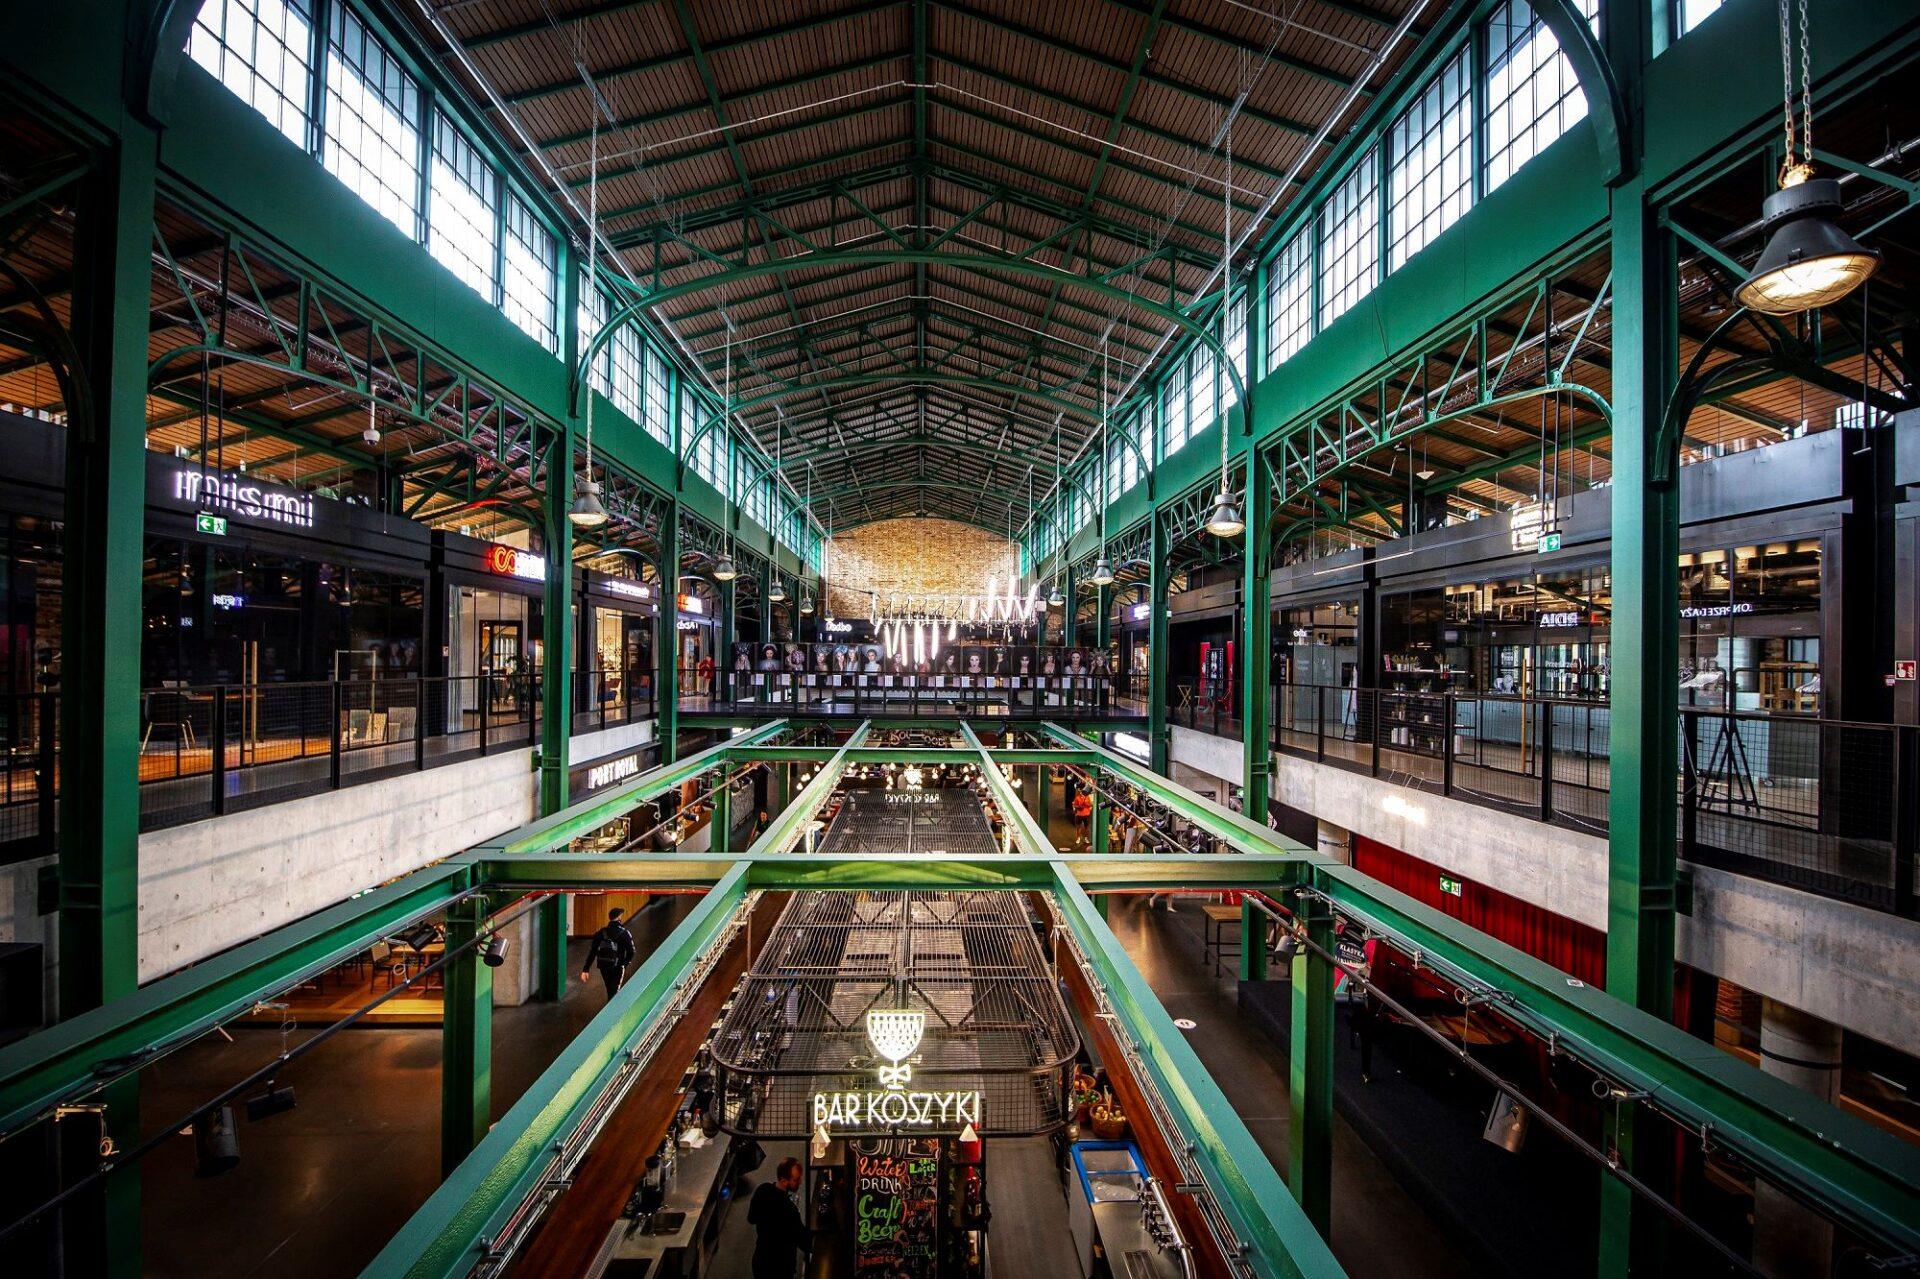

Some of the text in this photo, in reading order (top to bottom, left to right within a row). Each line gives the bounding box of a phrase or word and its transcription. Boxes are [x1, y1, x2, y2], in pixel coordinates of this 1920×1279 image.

[588, 754, 638, 789] PORT ROYAL
[814, 1092, 980, 1125] BAR KOSZYKI
[859, 1156, 907, 1177] Water
[861, 1177, 902, 1195] DRINK
[858, 1194, 902, 1226] Craft
[857, 1219, 901, 1244] Beer
